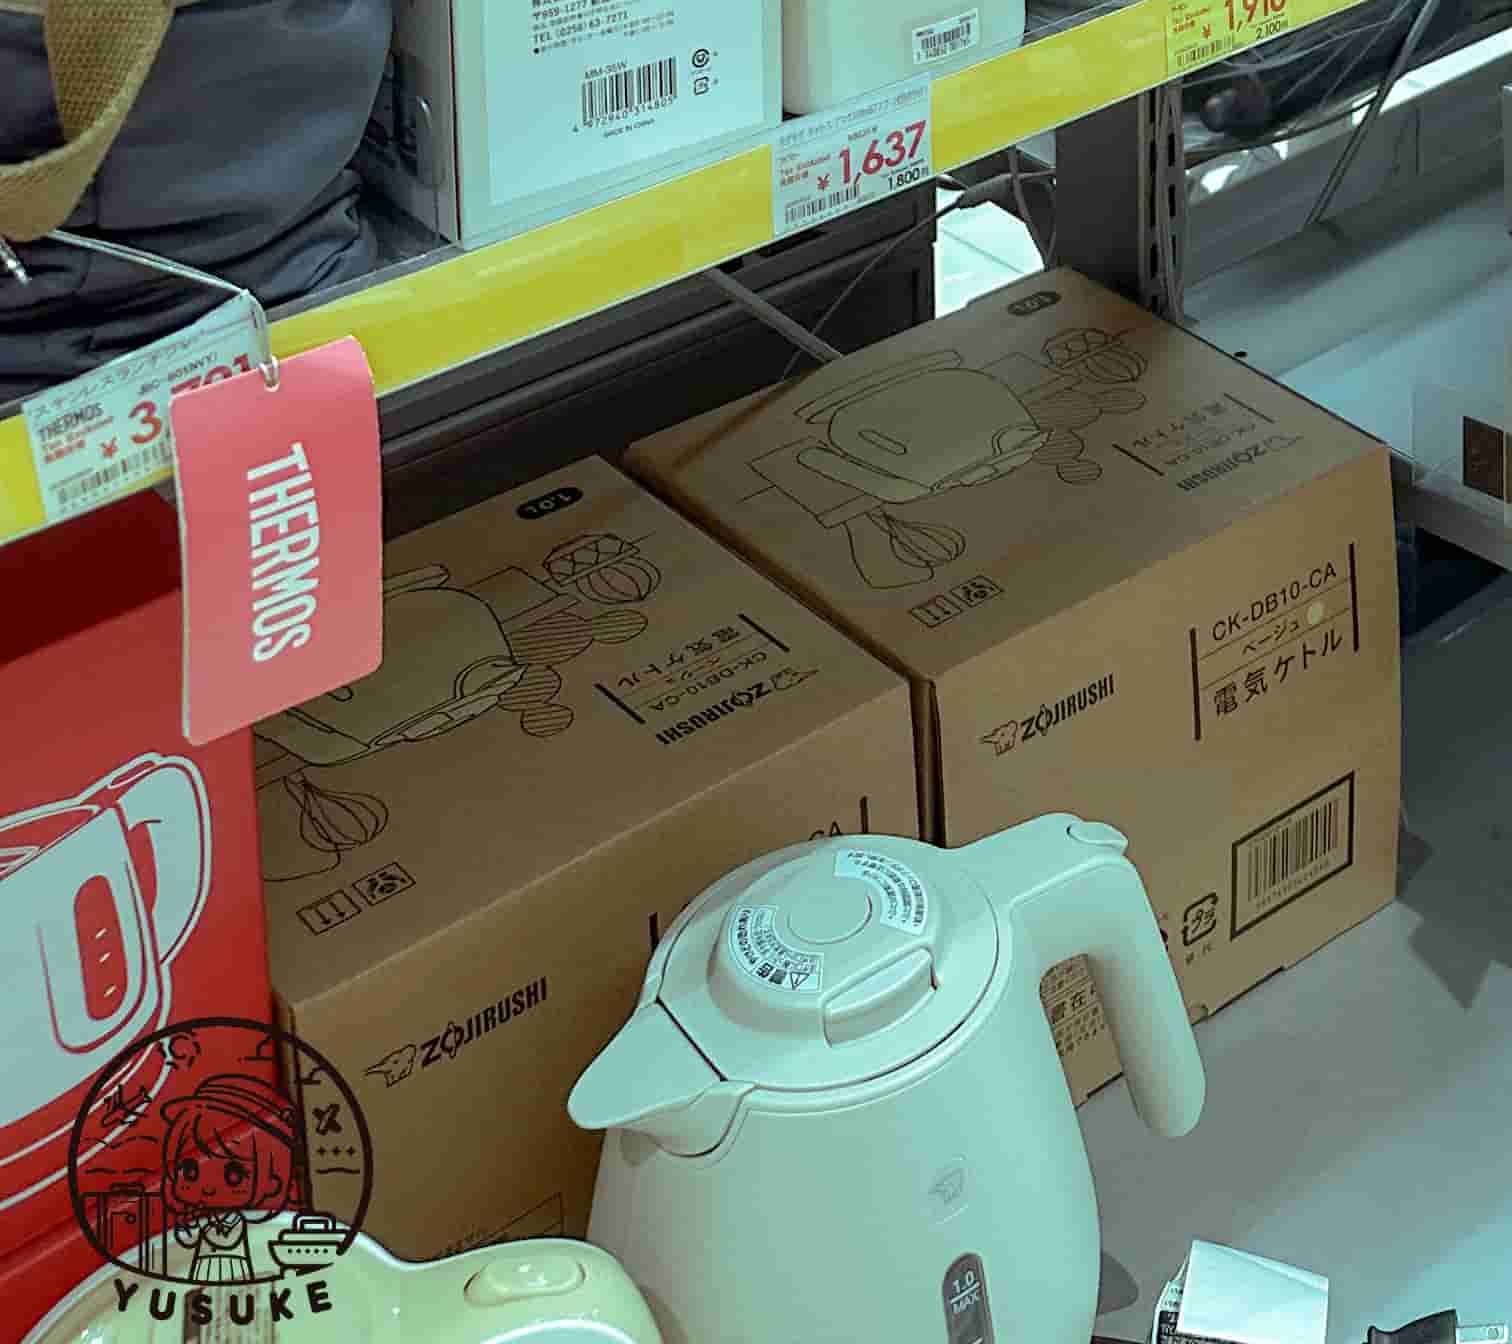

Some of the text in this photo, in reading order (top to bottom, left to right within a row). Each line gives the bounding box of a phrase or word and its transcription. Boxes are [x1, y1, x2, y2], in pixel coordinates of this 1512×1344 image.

[839, 119, 927, 187] 1,637
[38, 402, 105, 443] THERMOS
[247, 443, 320, 663] THERMOS
[1209, 559, 1339, 642] CK-DB10-CA
[1212, 628, 1344, 717] 電気ケトル
[1242, 618, 1300, 656] ベージュ
[654, 681, 772, 745] ZOJIRUSHI
[1020, 672, 1117, 746] ZOJIRUSHI
[419, 976, 550, 1072] ZOJIRUSHI
[950, 1269, 977, 1293] 1.0
